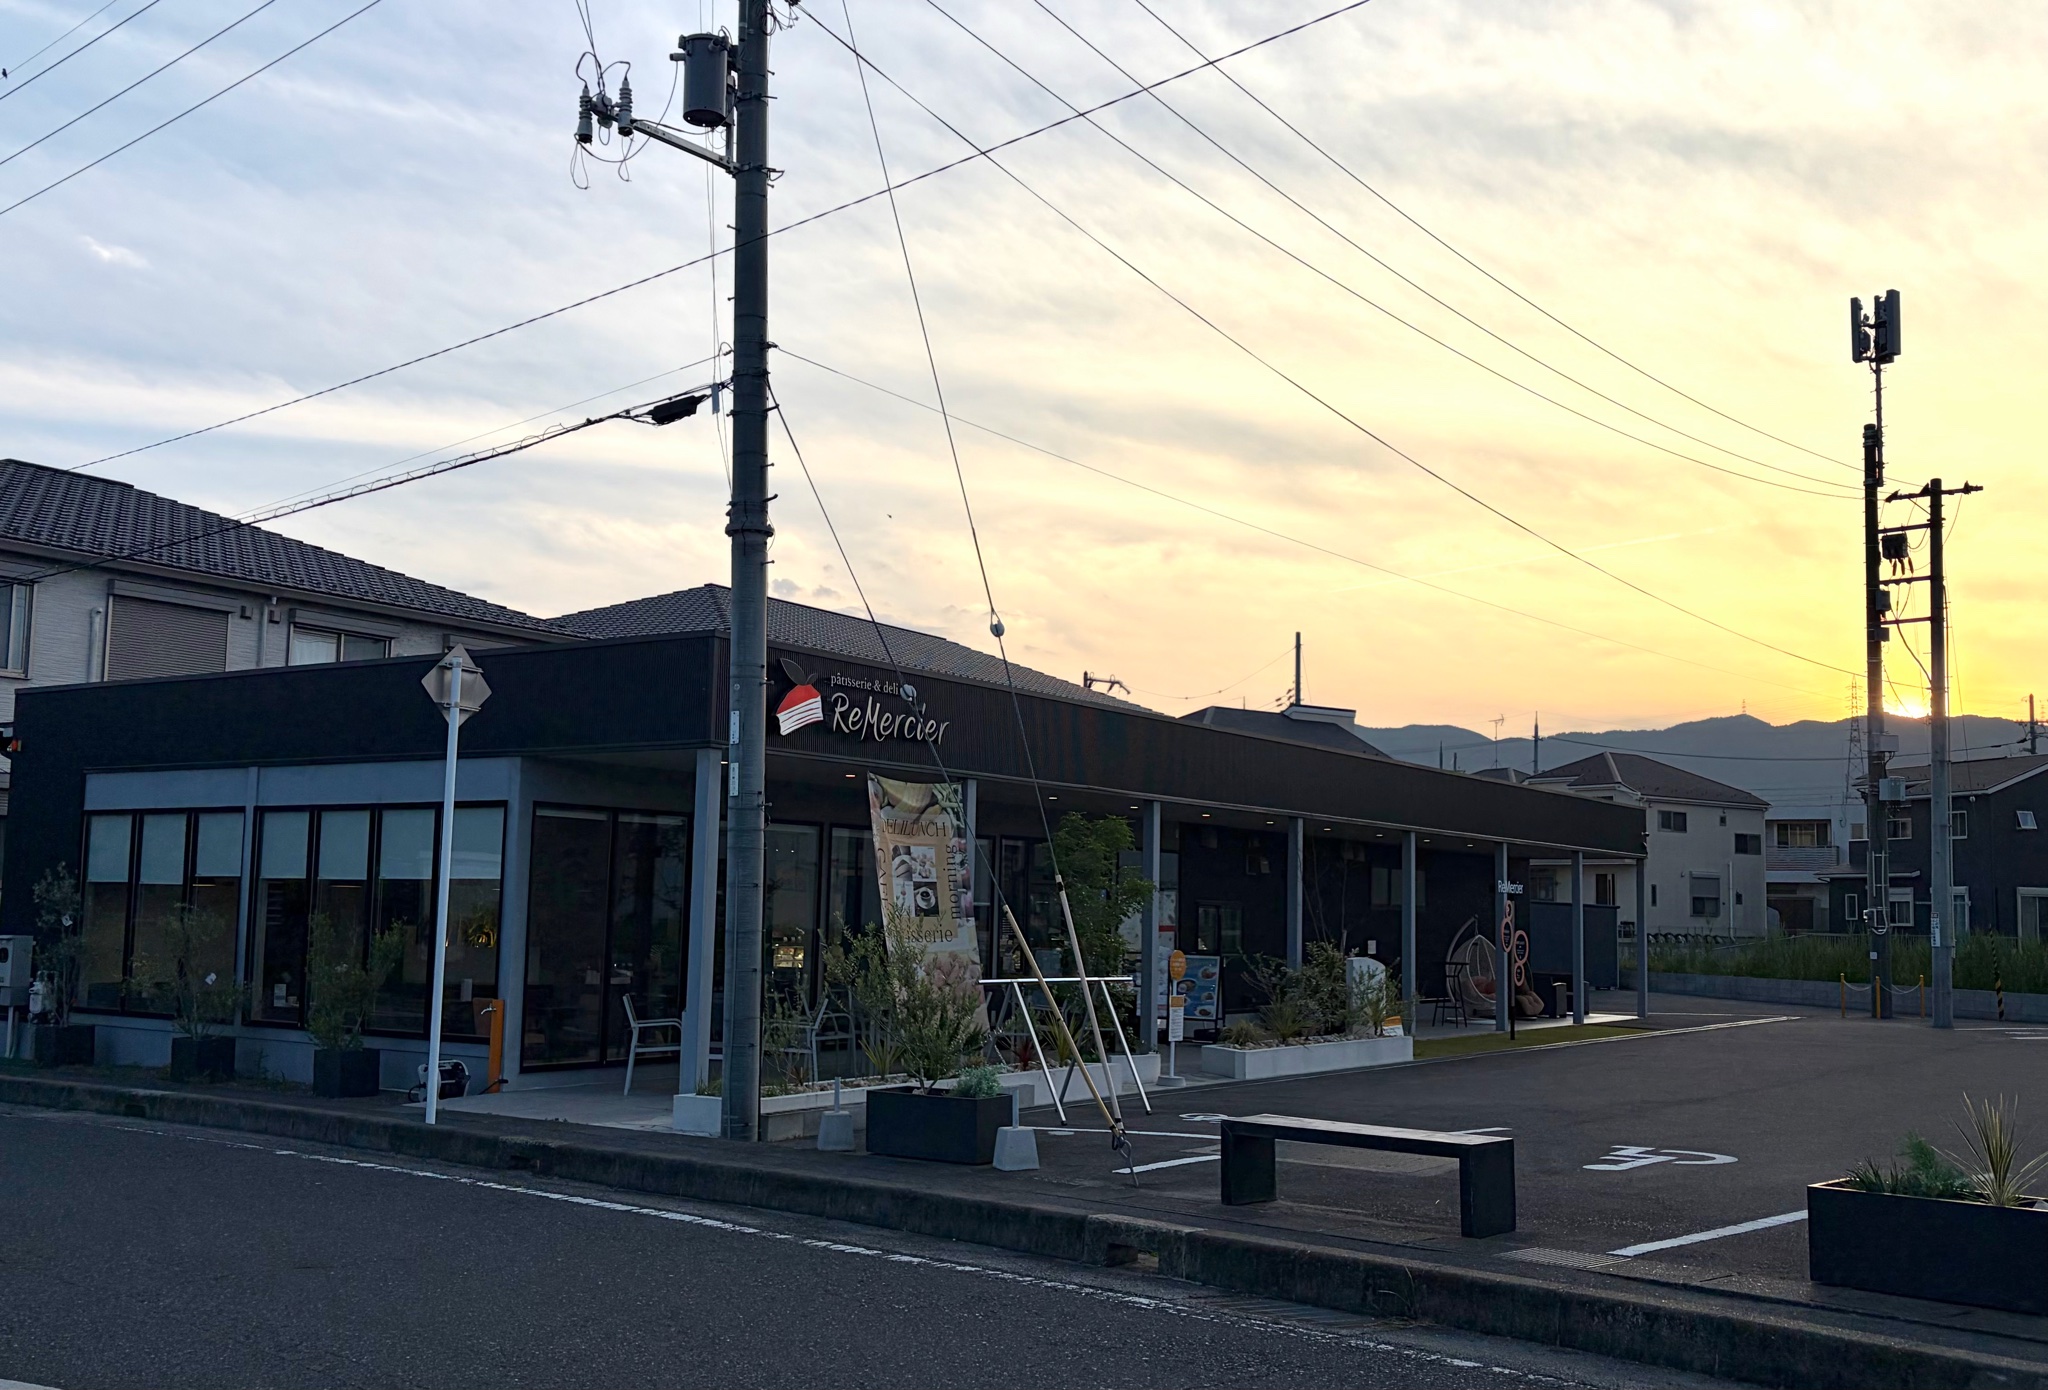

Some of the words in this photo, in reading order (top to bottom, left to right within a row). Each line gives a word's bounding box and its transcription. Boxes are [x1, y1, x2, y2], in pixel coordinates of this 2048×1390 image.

[873, 679, 881, 692] &
[883, 681, 899, 695] deli
[831, 692, 950, 745] ReMercier
[943, 844, 962, 920] morning
